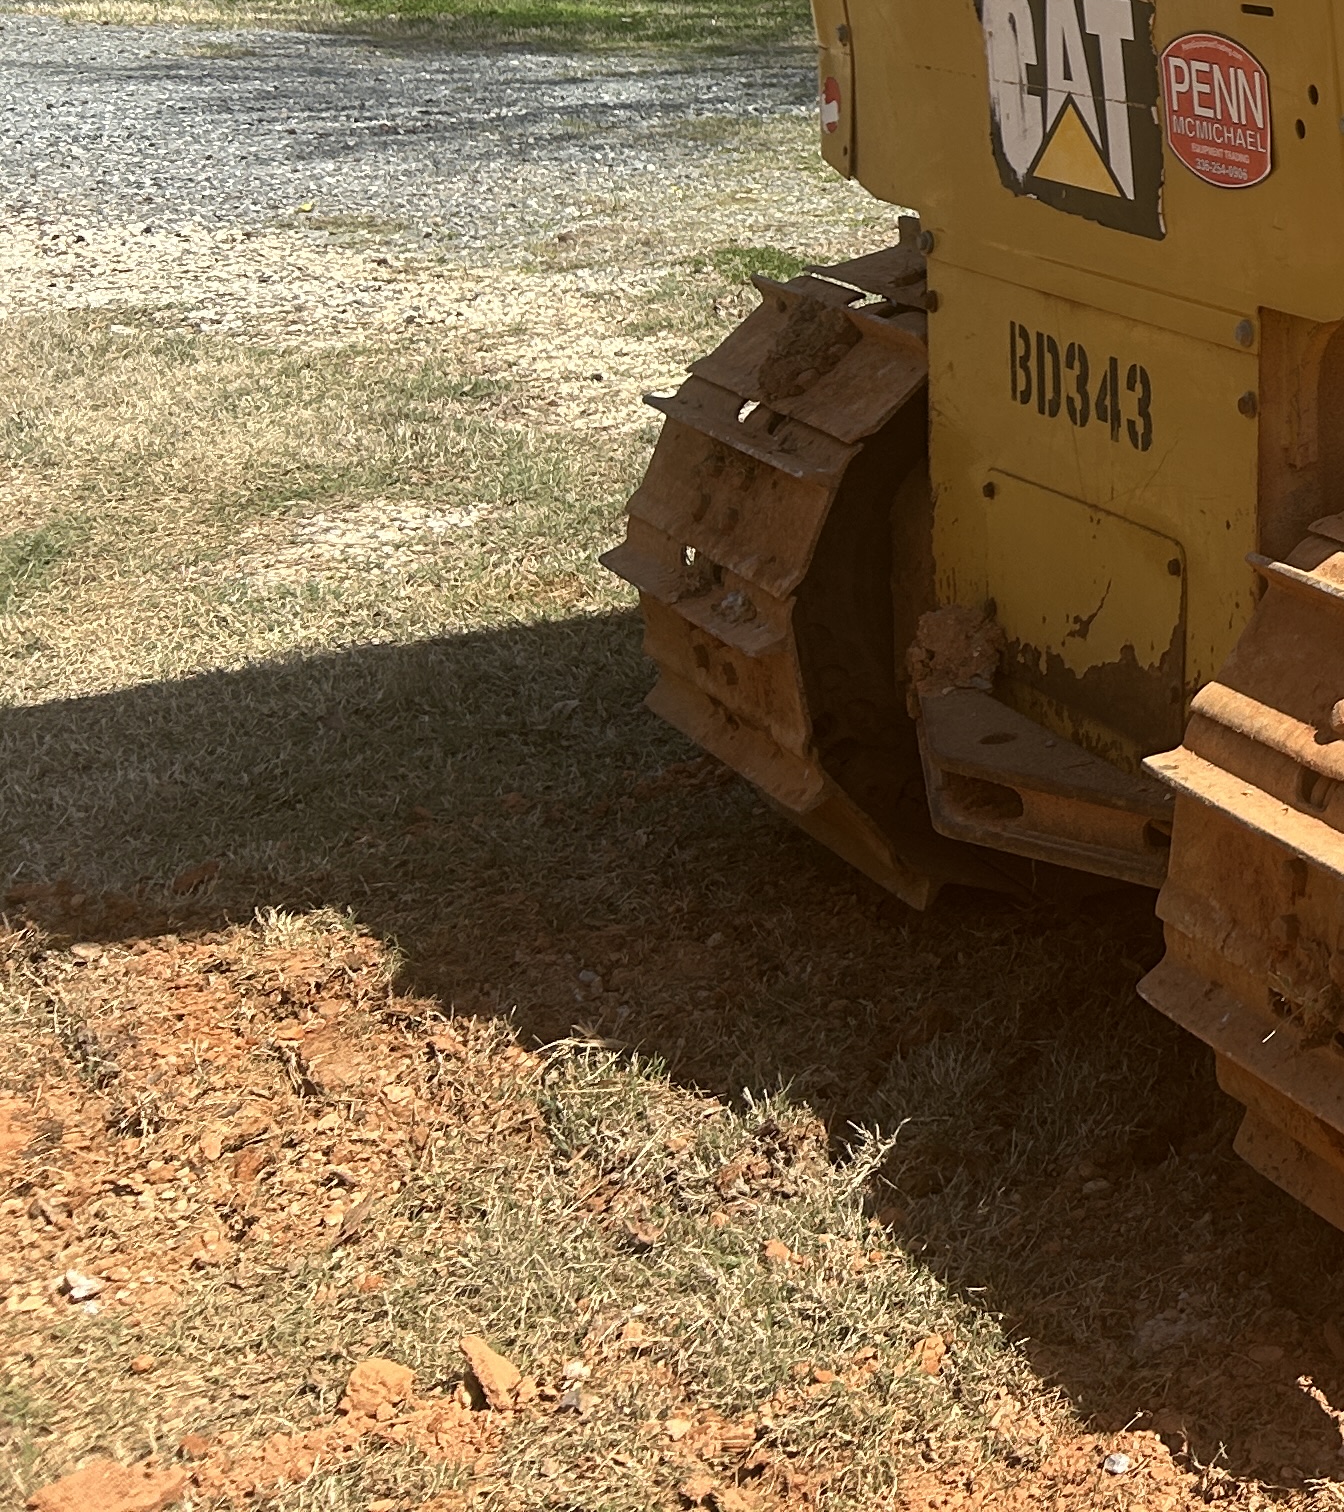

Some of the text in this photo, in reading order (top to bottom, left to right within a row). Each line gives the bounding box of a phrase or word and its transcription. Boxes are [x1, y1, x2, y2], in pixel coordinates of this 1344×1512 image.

[1168, 56, 1265, 129] PENN
[1173, 114, 1267, 153] MCMICHAEL
[1009, 320, 1153, 452] BD343
